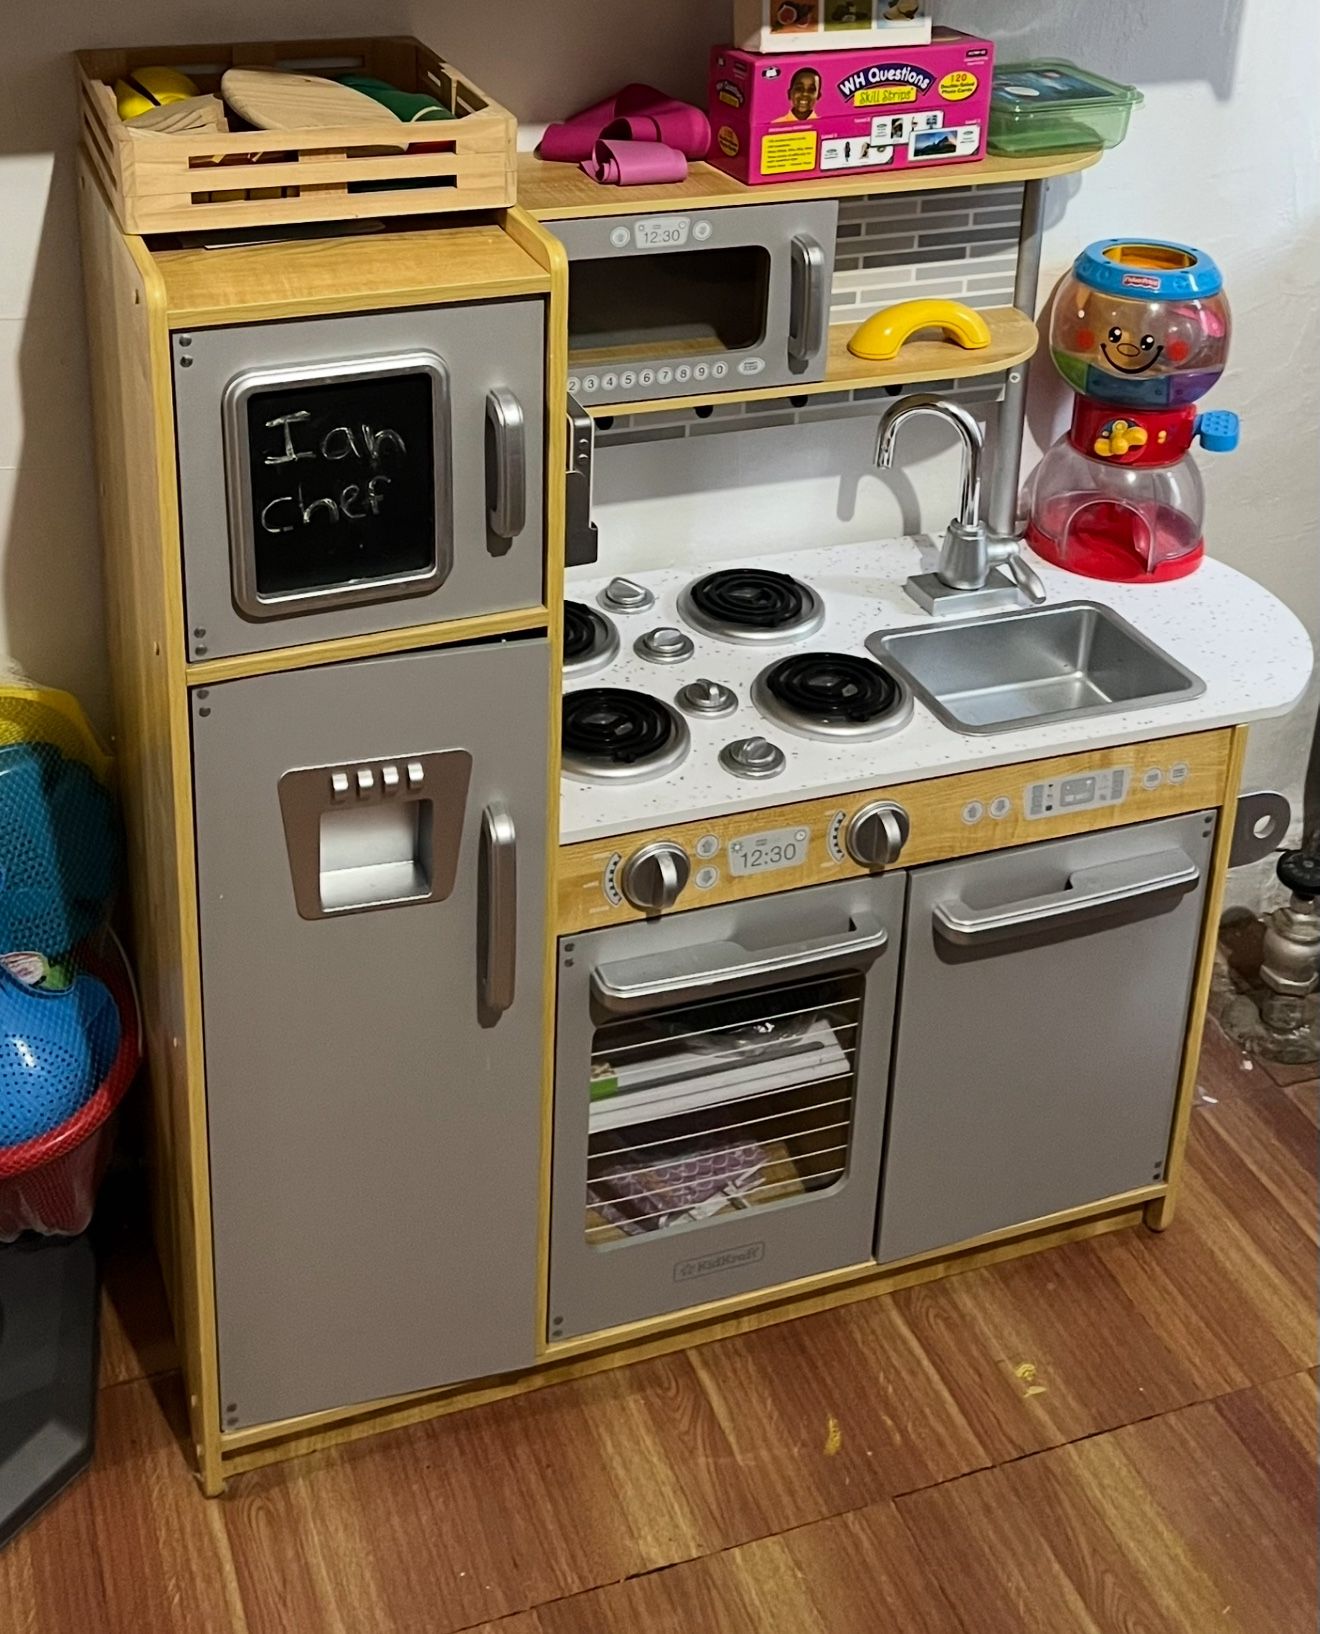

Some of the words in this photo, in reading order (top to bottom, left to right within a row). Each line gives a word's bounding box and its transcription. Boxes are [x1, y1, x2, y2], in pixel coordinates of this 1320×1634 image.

[839, 71, 866, 96] WH
[868, 66, 930, 89] Questions
[951, 73, 968, 83] 120
[859, 90, 880, 104] Skill
[881, 88, 912, 102] Strips
[643, 229, 681, 244] 12:30
[568, 380, 577, 392] 2
[587, 378, 595, 389] 3
[606, 376, 614, 387] 4
[624, 374, 632, 385] 5
[643, 372, 651, 383] 6
[662, 370, 670, 381] 7
[680, 368, 688, 379] 8
[698, 366, 706, 378] 9
[716, 364, 724, 375] 0
[264, 409, 316, 465] I
[740, 842, 797, 869] 12:30
